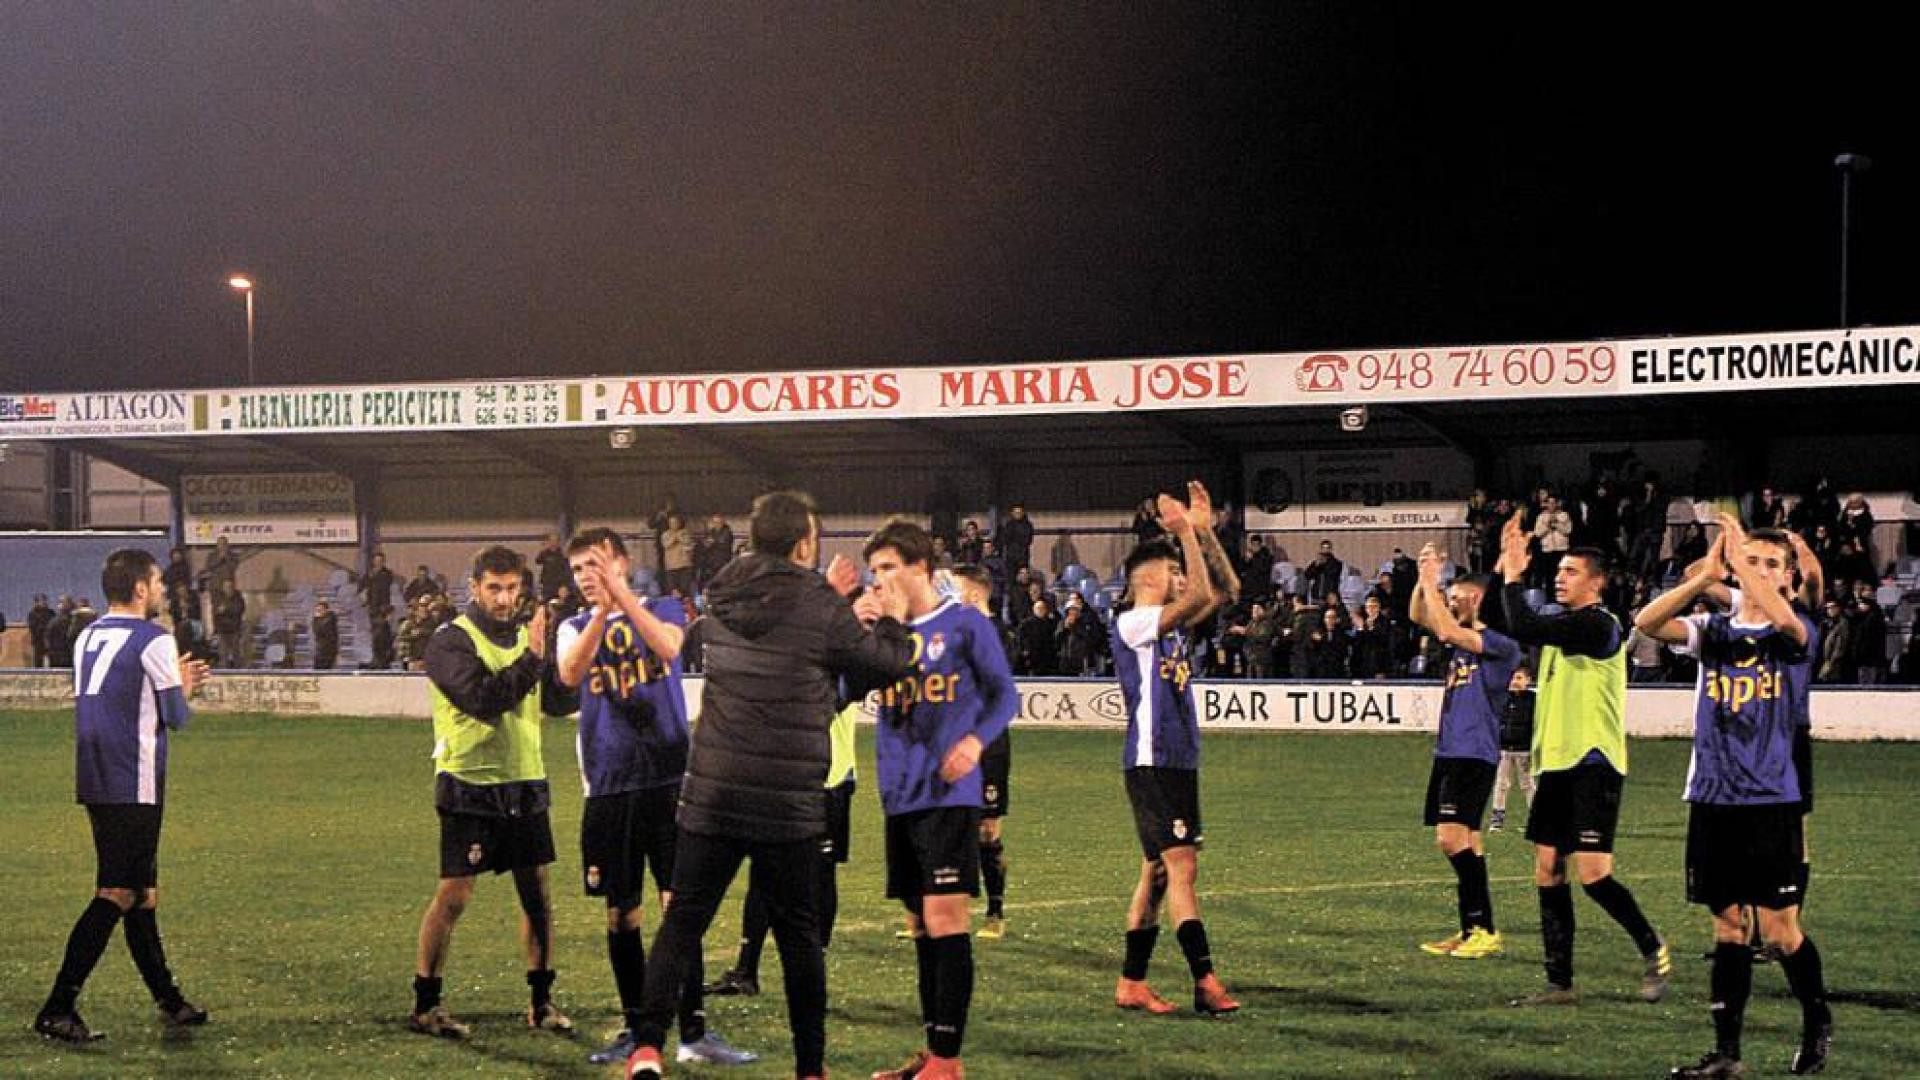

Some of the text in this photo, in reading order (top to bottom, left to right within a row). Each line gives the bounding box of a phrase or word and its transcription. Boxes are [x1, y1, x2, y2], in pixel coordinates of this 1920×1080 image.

[1632, 331, 1920, 384] ELECTROMECÁNIC
[616, 346, 1616, 416] AUTOCARES MARIA JOSE 948 74 60 59
[66, 393, 186, 420] ALTAGON
[1318, 514, 1377, 525] PAMPLONA
[1391, 513, 1441, 525] ESTELLA
[1204, 688, 1401, 724] BAR TUBAL
